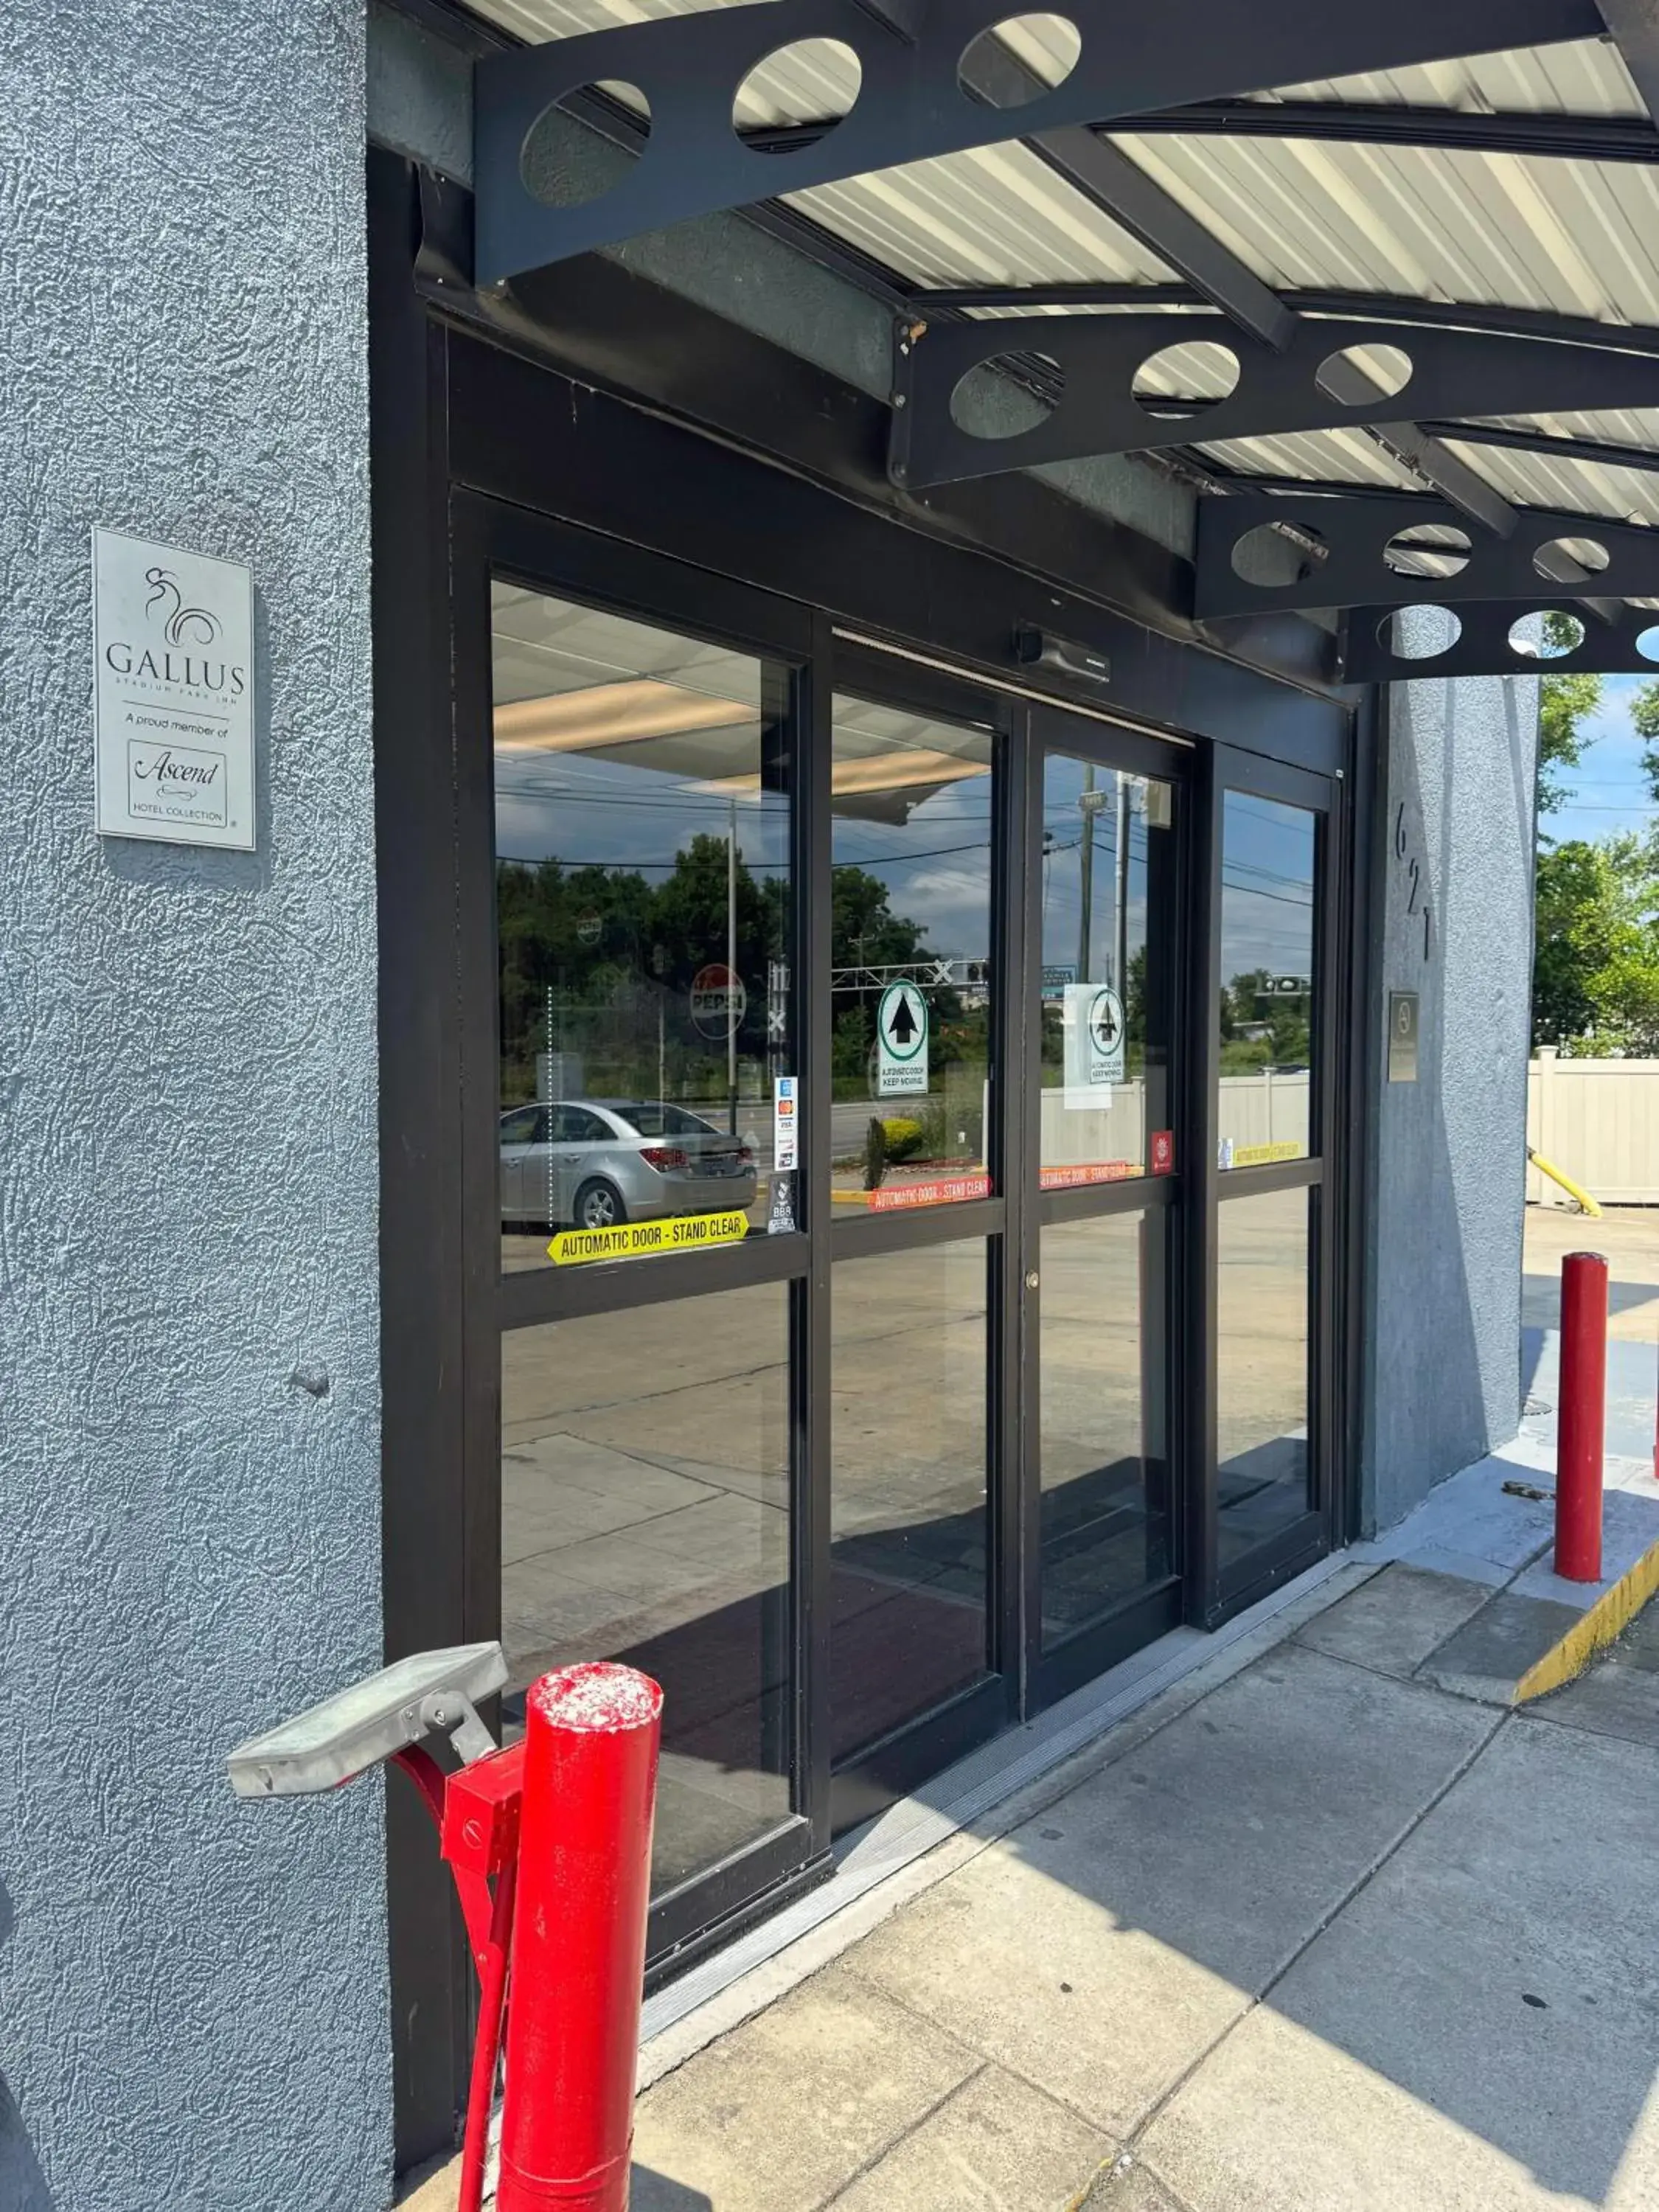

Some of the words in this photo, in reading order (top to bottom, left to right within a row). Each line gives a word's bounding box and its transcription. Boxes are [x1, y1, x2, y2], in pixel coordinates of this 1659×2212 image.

[105, 642, 245, 695] GALLUS
[125, 712, 134, 723] A
[135, 715, 170, 729] proud
[171, 720, 215, 736] member
[218, 729, 229, 738] of
[134, 751, 219, 785] Ascend
[133, 802, 163, 815] HOTEL
[166, 806, 223, 821] COLLECTION
[692, 993, 743, 1011] PEPSI
[875, 1186, 917, 1208] AUTOMATIC
[918, 1186, 939, 1203] DOOR
[943, 1181, 966, 1199] STAND
[967, 1178, 989, 1197] CLEAR
[561, 1232, 629, 1257] AUTOMATIC
[632, 1226, 662, 1248] DOOR
[672, 1222, 706, 1242] STAND
[710, 1217, 741, 1237] CLEAR
